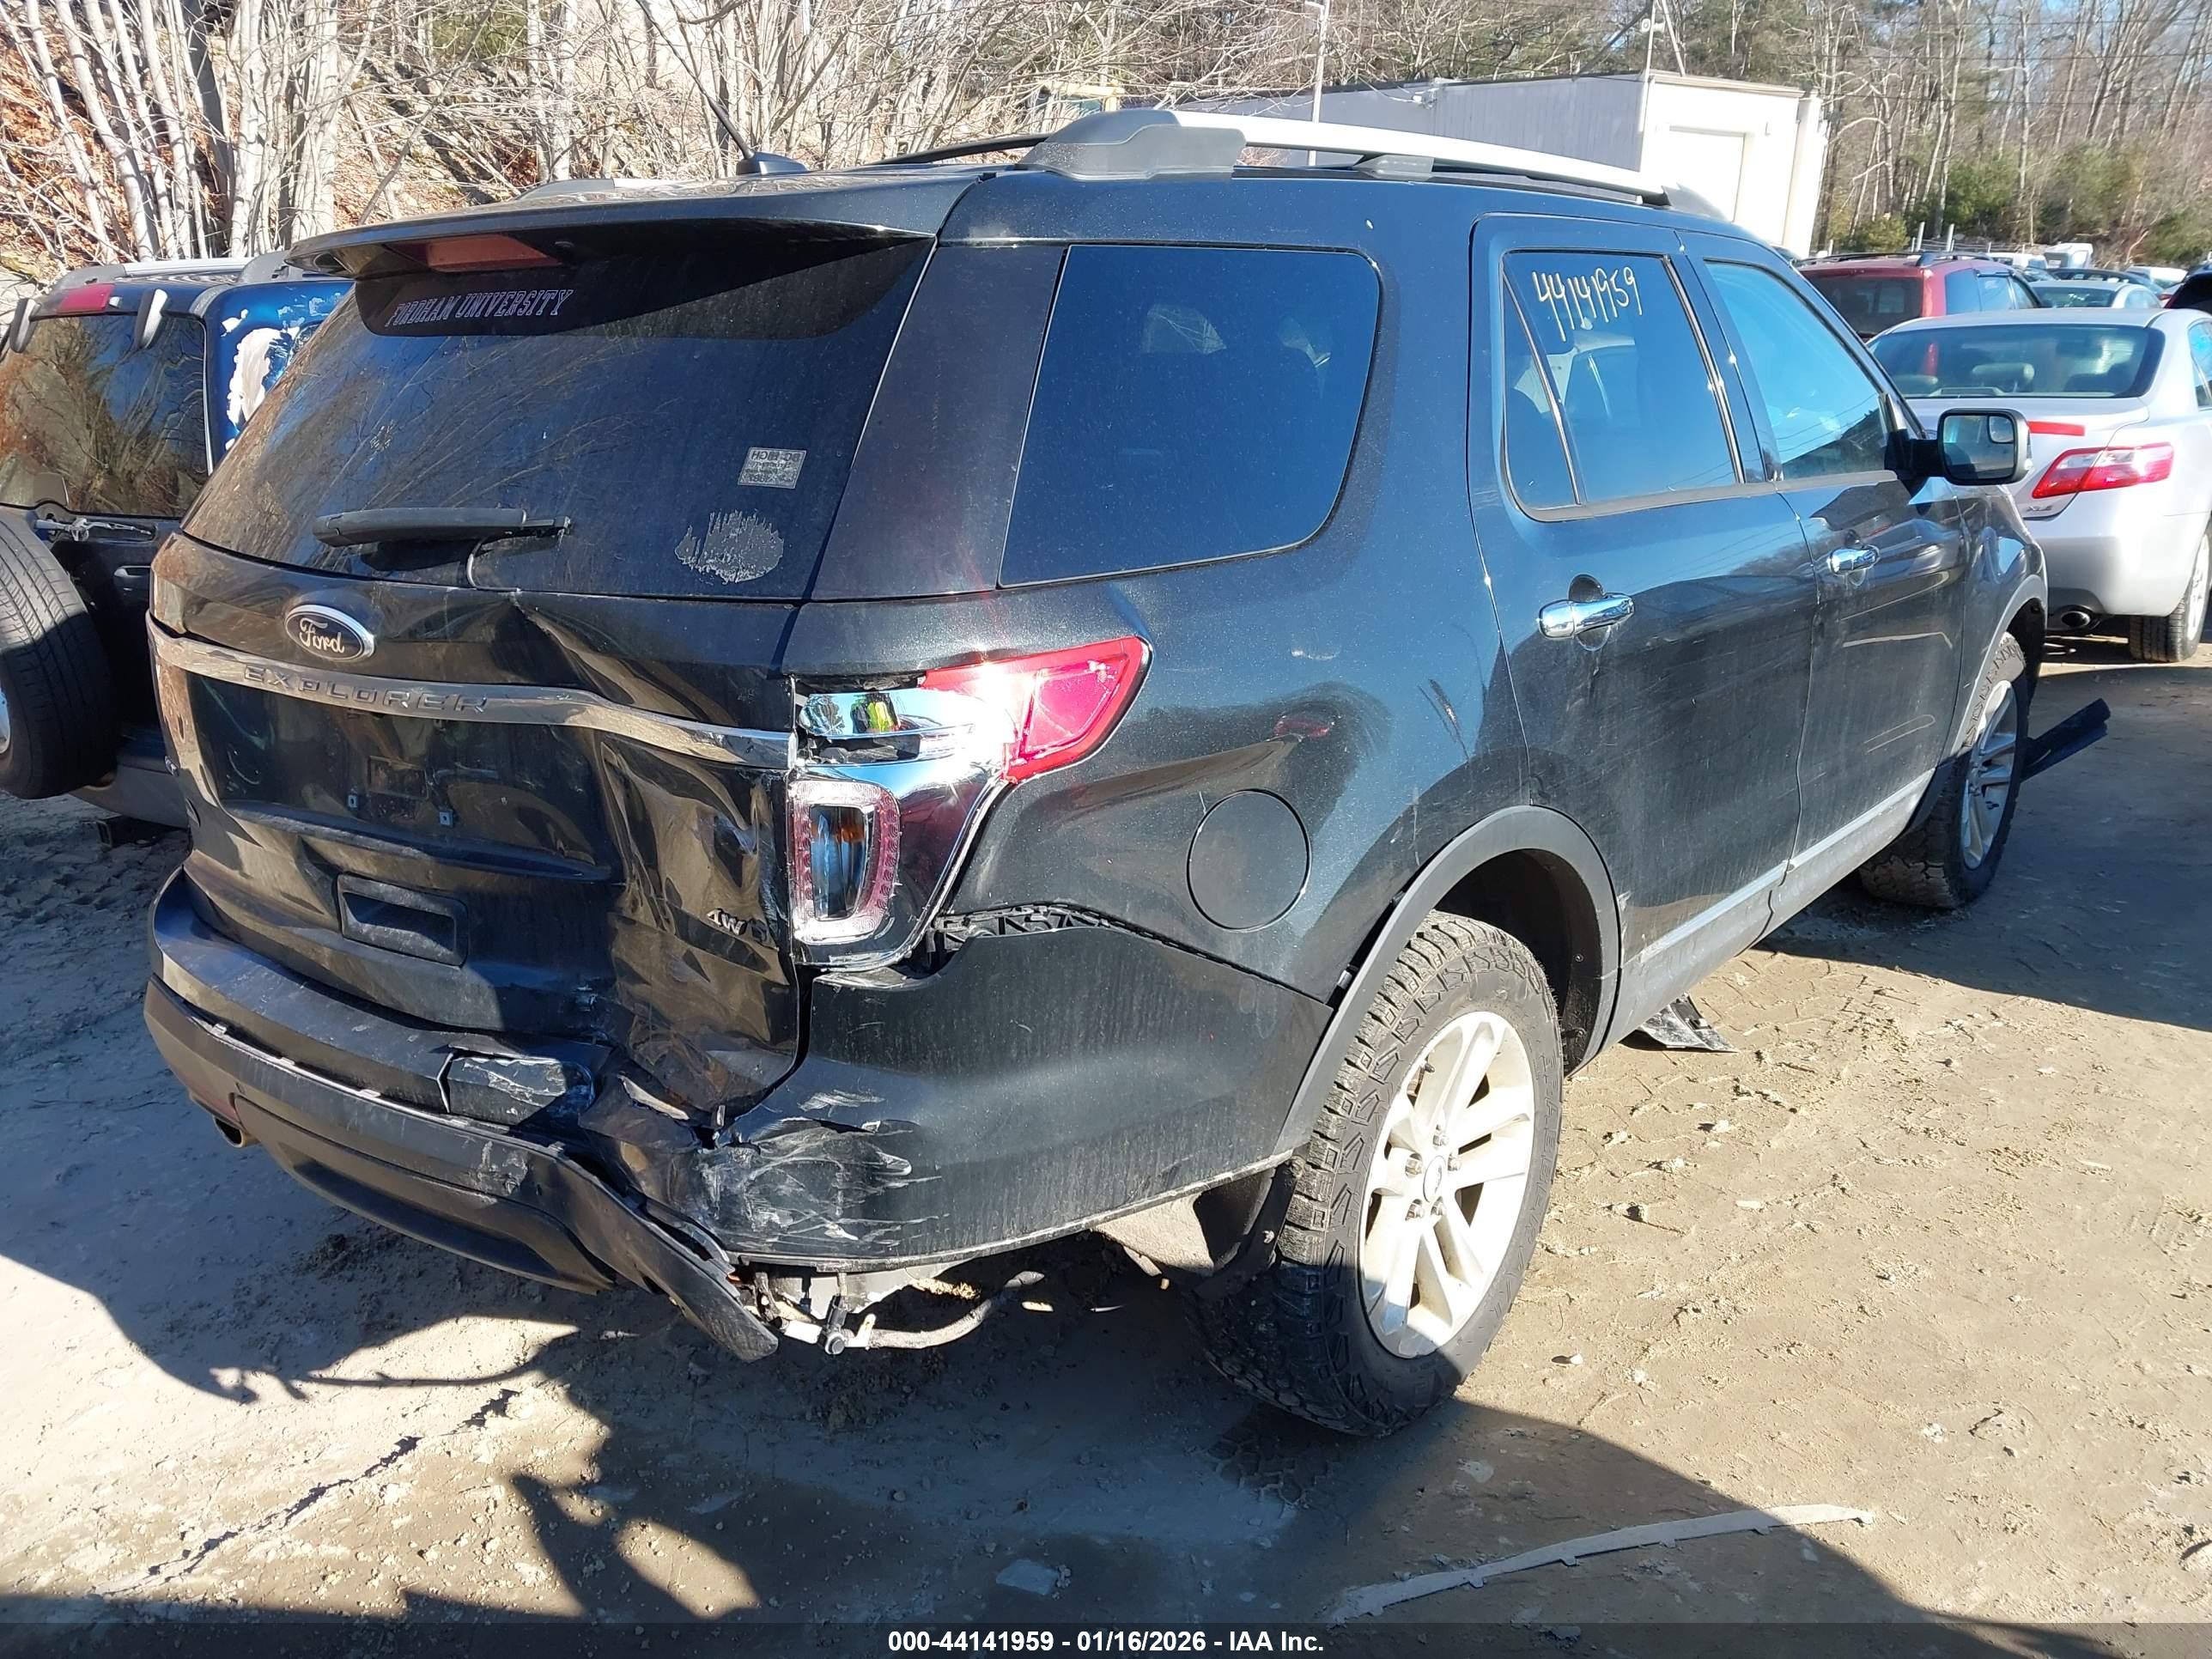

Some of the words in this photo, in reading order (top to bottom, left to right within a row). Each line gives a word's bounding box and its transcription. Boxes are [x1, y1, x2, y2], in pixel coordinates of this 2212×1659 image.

[385, 296, 460, 328] FORDHAM
[455, 289, 574, 319] UNIVERSITY
[1532, 266, 1643, 343] 44141959
[298, 617, 345, 654] Ford
[244, 664, 489, 714] EXPLORER
